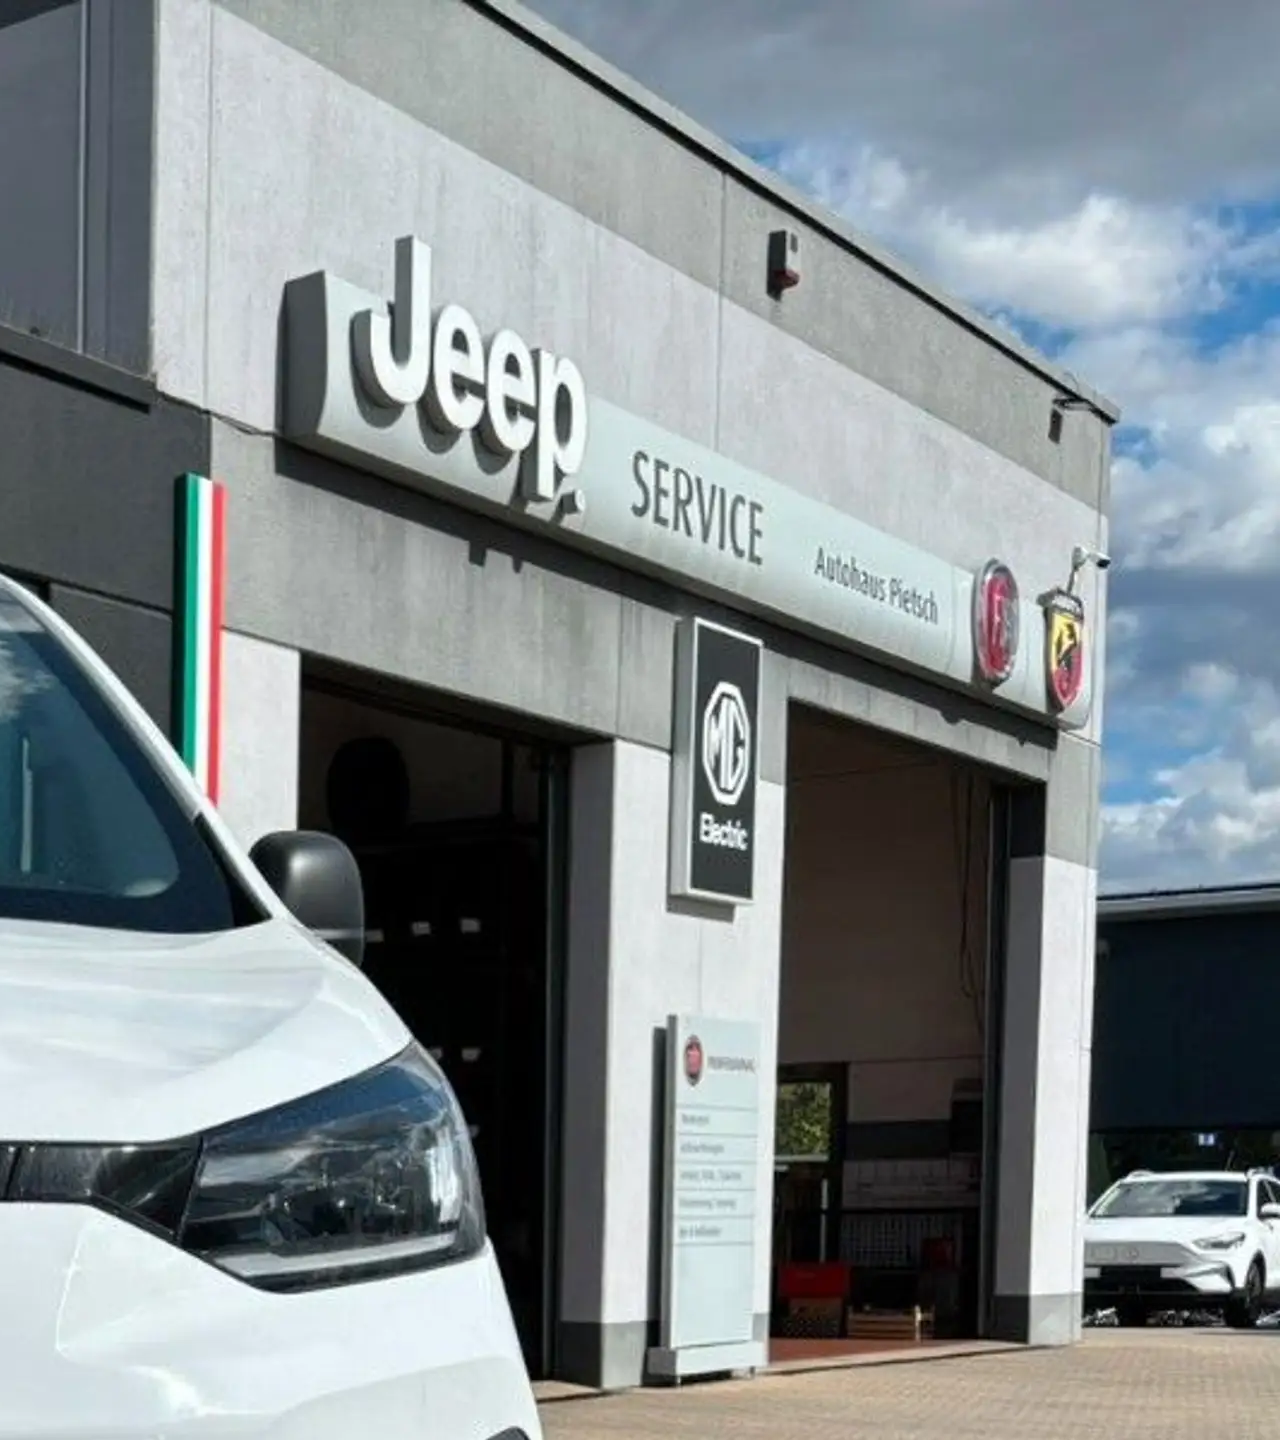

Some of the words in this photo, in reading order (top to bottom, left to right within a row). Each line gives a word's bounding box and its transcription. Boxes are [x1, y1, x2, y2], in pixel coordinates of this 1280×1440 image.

[350, 235, 588, 500] Jeep
[630, 450, 764, 566] SERVICE
[814, 548, 886, 602] Autohaus
[889, 576, 939, 626] Pietsch
[709, 696, 745, 791] MG
